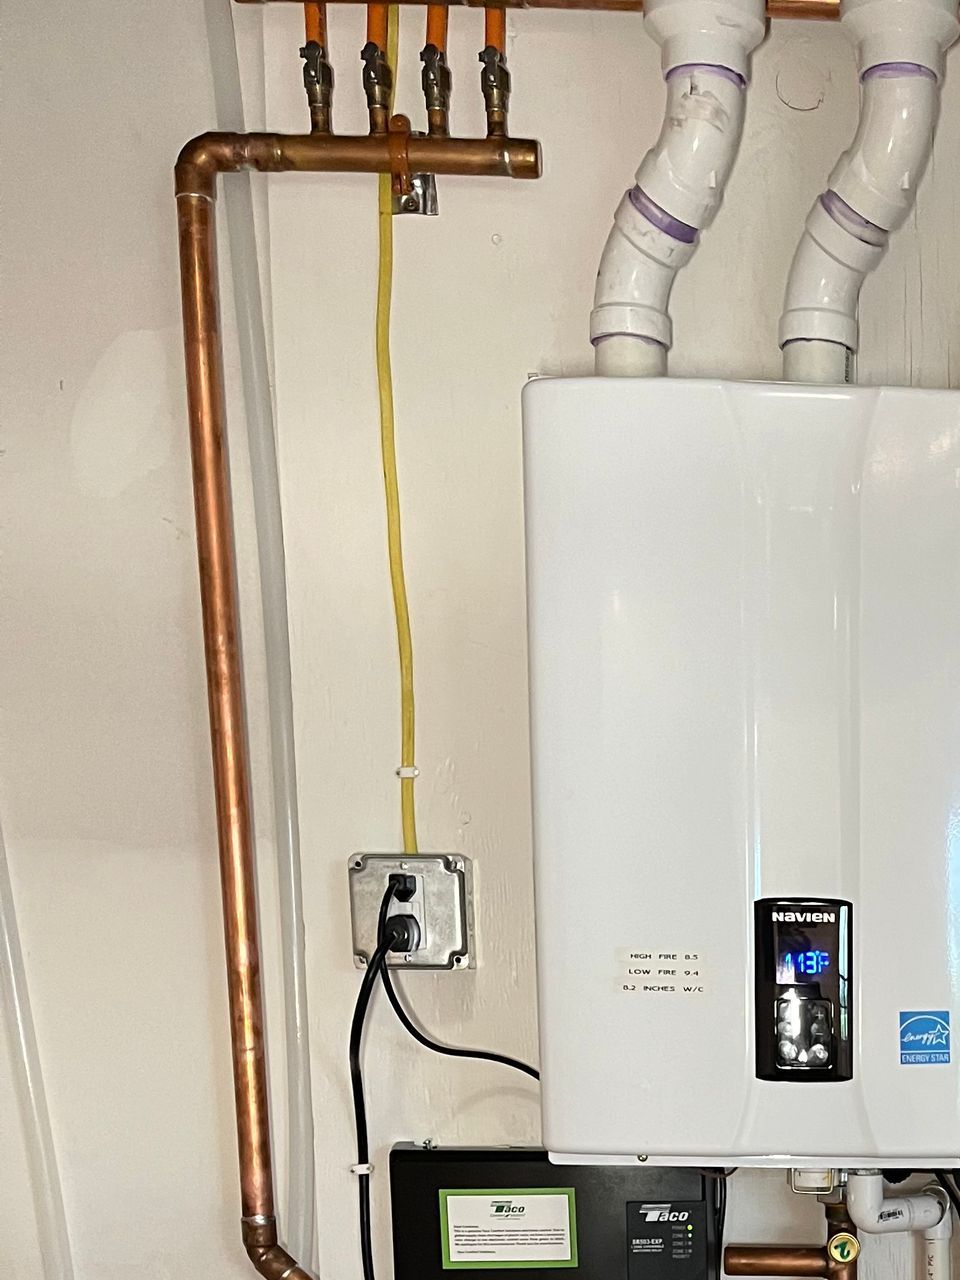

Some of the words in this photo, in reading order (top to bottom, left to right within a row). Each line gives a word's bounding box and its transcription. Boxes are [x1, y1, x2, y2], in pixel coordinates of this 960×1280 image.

[902, 1054, 930, 1063] ENERGY
[931, 1054, 949, 1062] STAR
[490, 1200, 525, 1214] Taco
[639, 1204, 689, 1222] Taco
